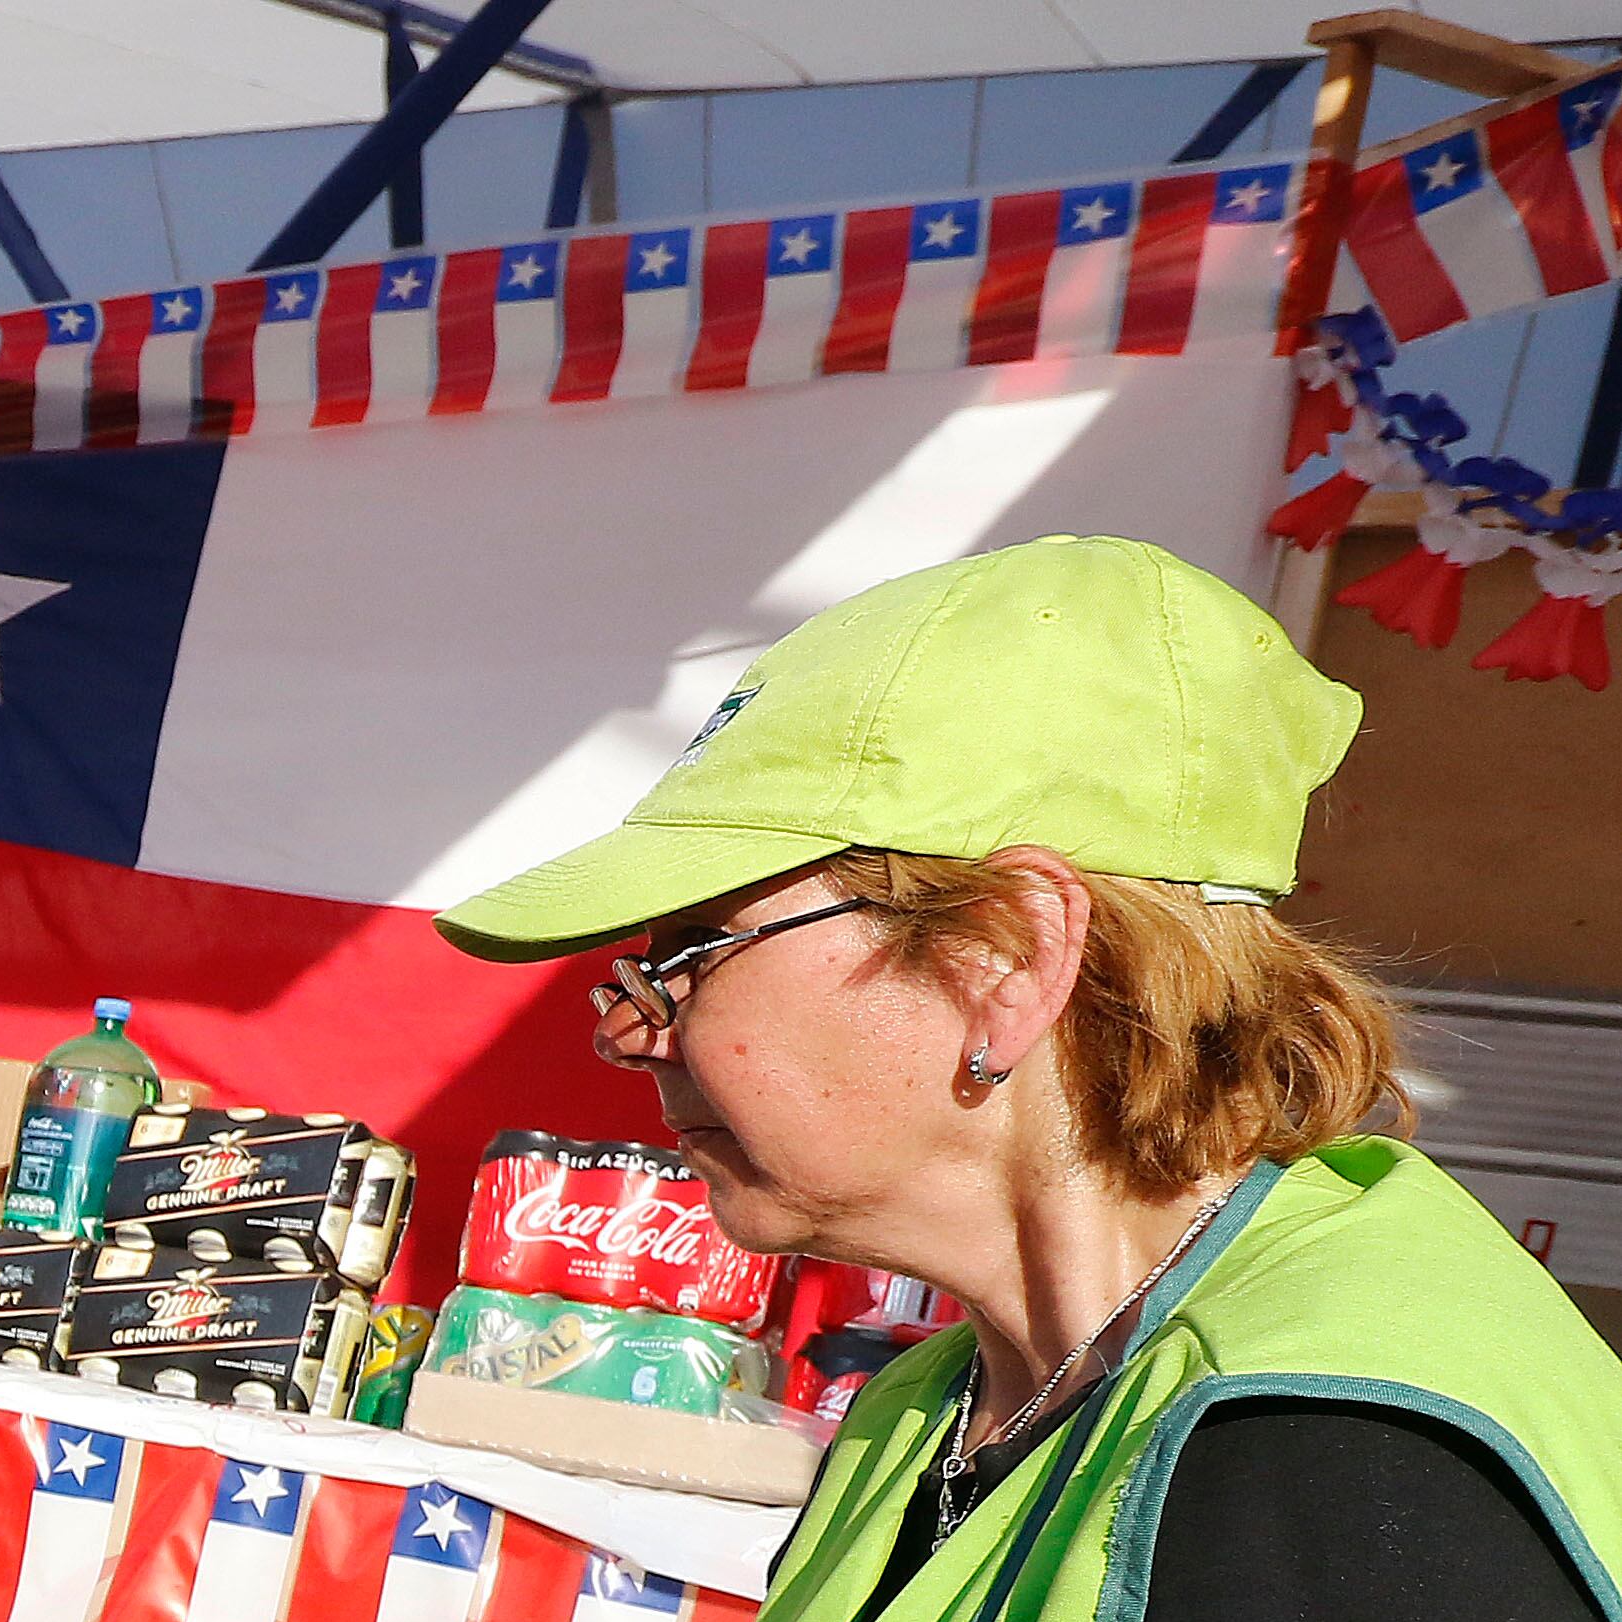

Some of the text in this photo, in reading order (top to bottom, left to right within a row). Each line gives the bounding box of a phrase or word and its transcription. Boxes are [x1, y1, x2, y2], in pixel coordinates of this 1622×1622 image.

[180, 1154, 263, 1191] Miller
[556, 1149, 692, 1180] SIN AZÚCAR
[146, 1178, 287, 1211] GENUINE DRAFT
[503, 1188, 709, 1266] Coca-Cola
[147, 1291, 233, 1326] Miller
[112, 1320, 258, 1345] GENUINE DRAFT
